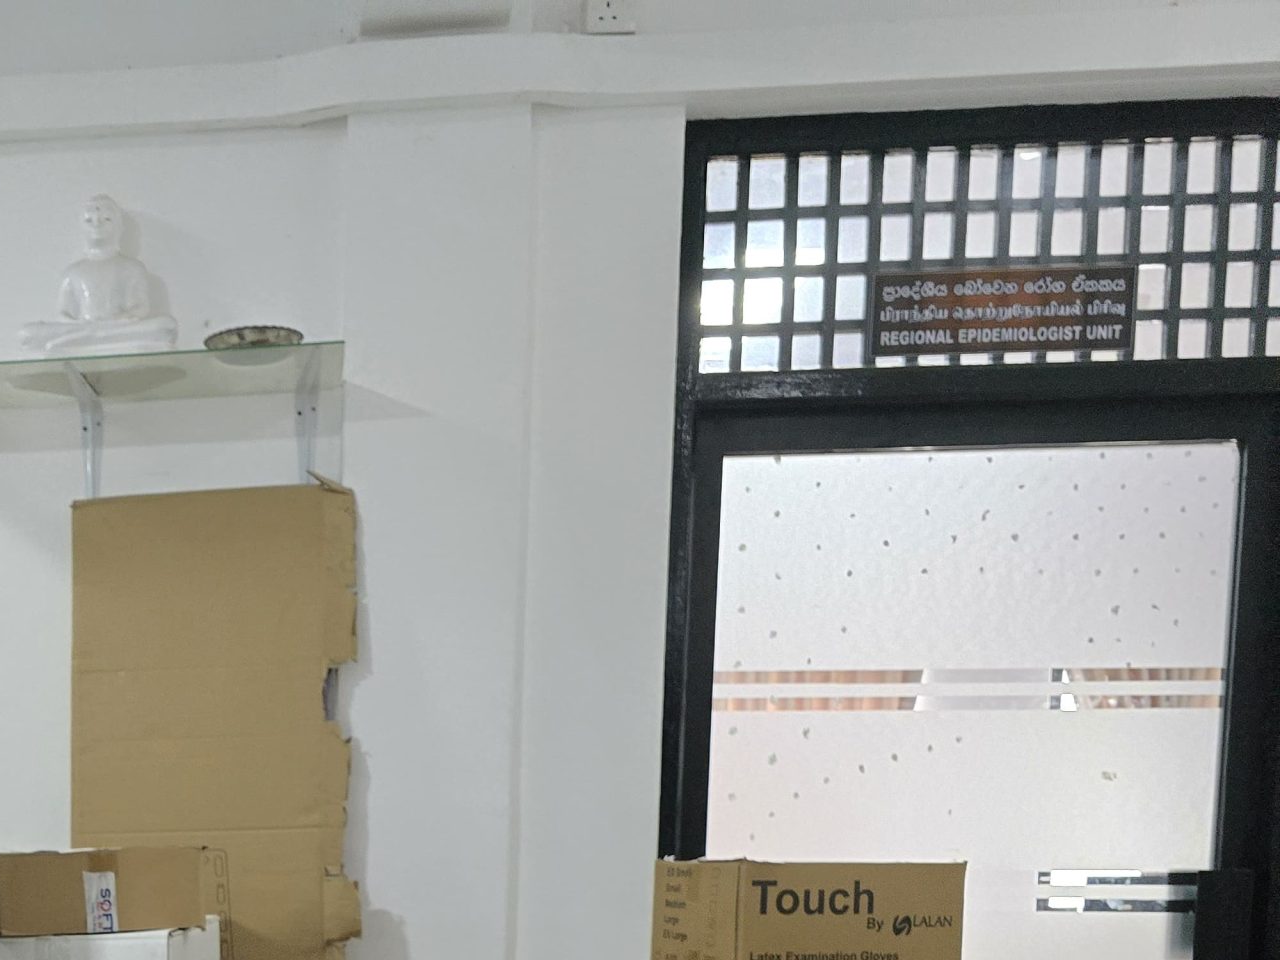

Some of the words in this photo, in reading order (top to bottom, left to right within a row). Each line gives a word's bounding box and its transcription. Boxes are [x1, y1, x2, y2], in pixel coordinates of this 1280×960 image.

[880, 329, 954, 346] REGIONAL
[958, 325, 1083, 344] EPIDEMIOLOGIST
[1086, 324, 1124, 340] UNIT
[752, 879, 875, 916] Touch
[867, 917, 884, 932] By
[912, 915, 953, 929] LALAN
